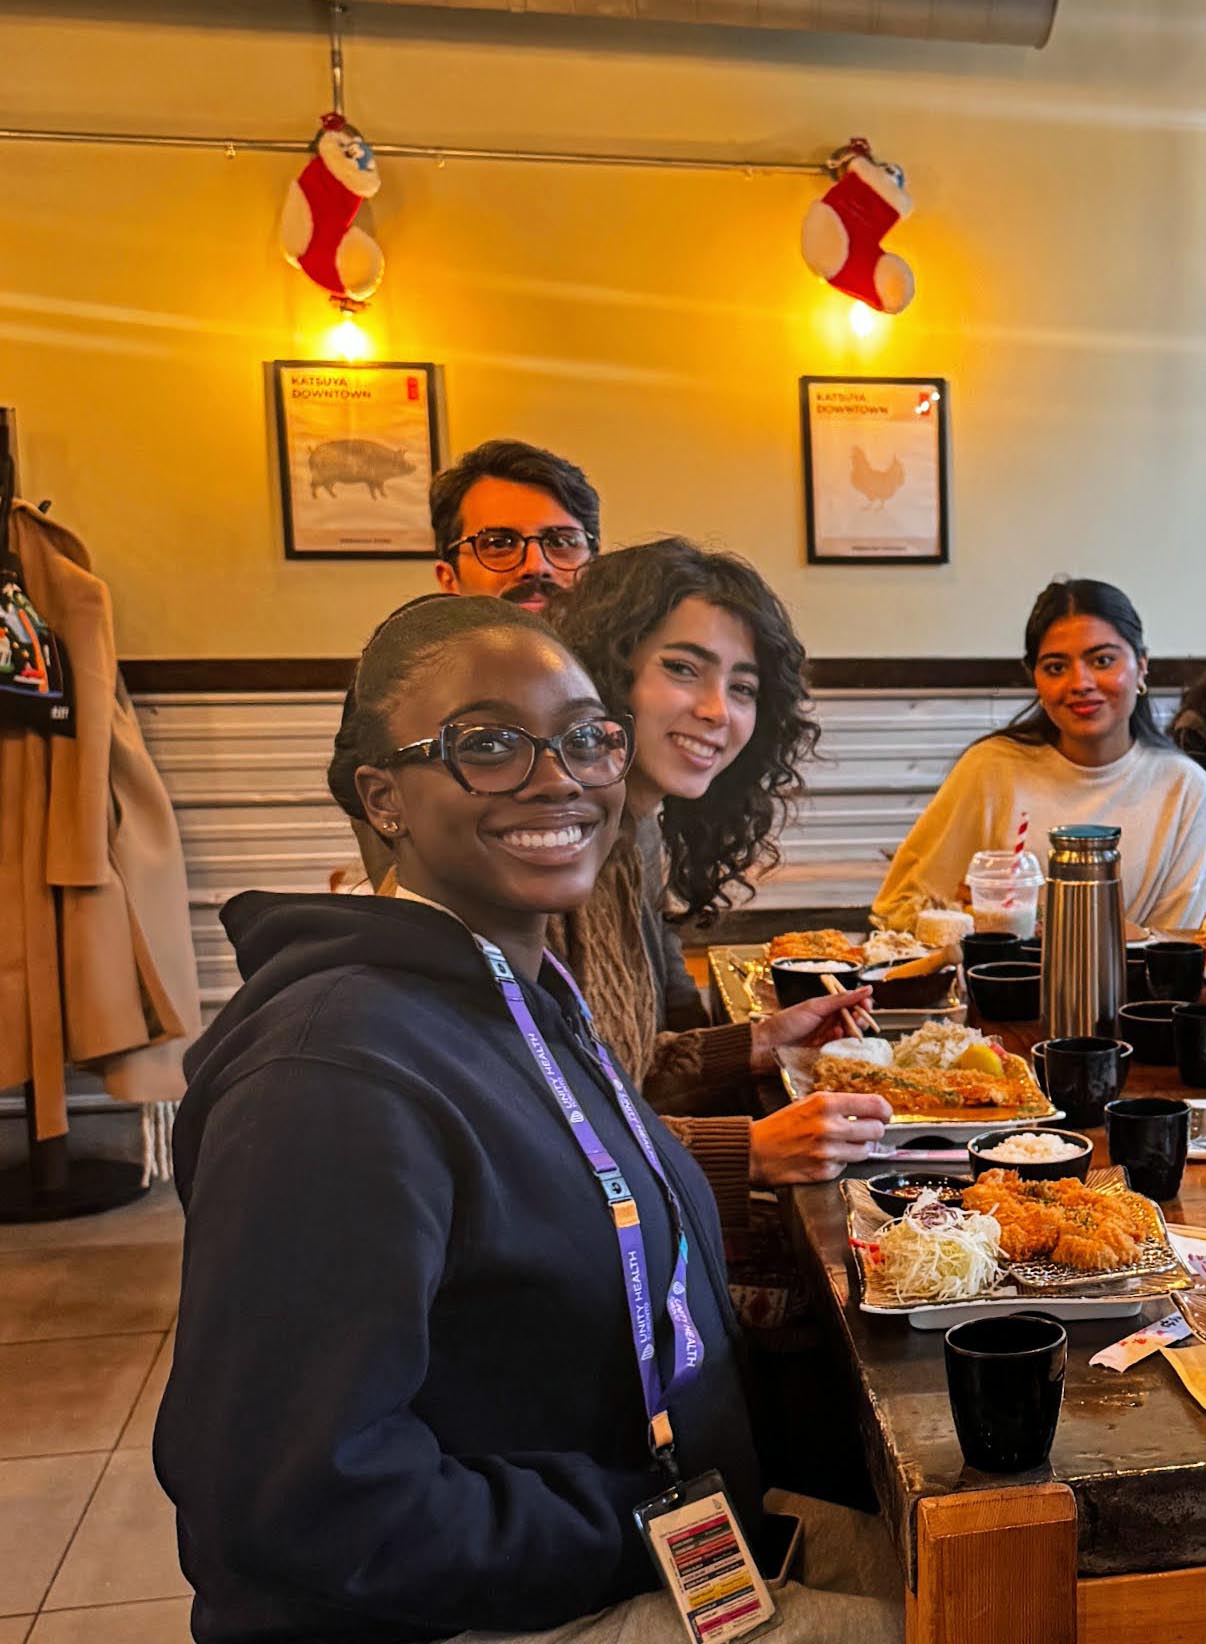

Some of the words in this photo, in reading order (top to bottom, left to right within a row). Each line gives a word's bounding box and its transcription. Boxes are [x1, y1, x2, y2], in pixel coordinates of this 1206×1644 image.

[291, 377, 348, 387] KATSUYA
[292, 390, 371, 400] DOWNTOWN
[816, 405, 888, 415] DOWNTOWN
[528, 1033, 555, 1075] HEALTH
[550, 1077, 572, 1109] UNITY
[628, 1250, 643, 1301] HEALTH
[636, 1305, 648, 1343] UNITY
[683, 1324, 698, 1367] HEALTH
